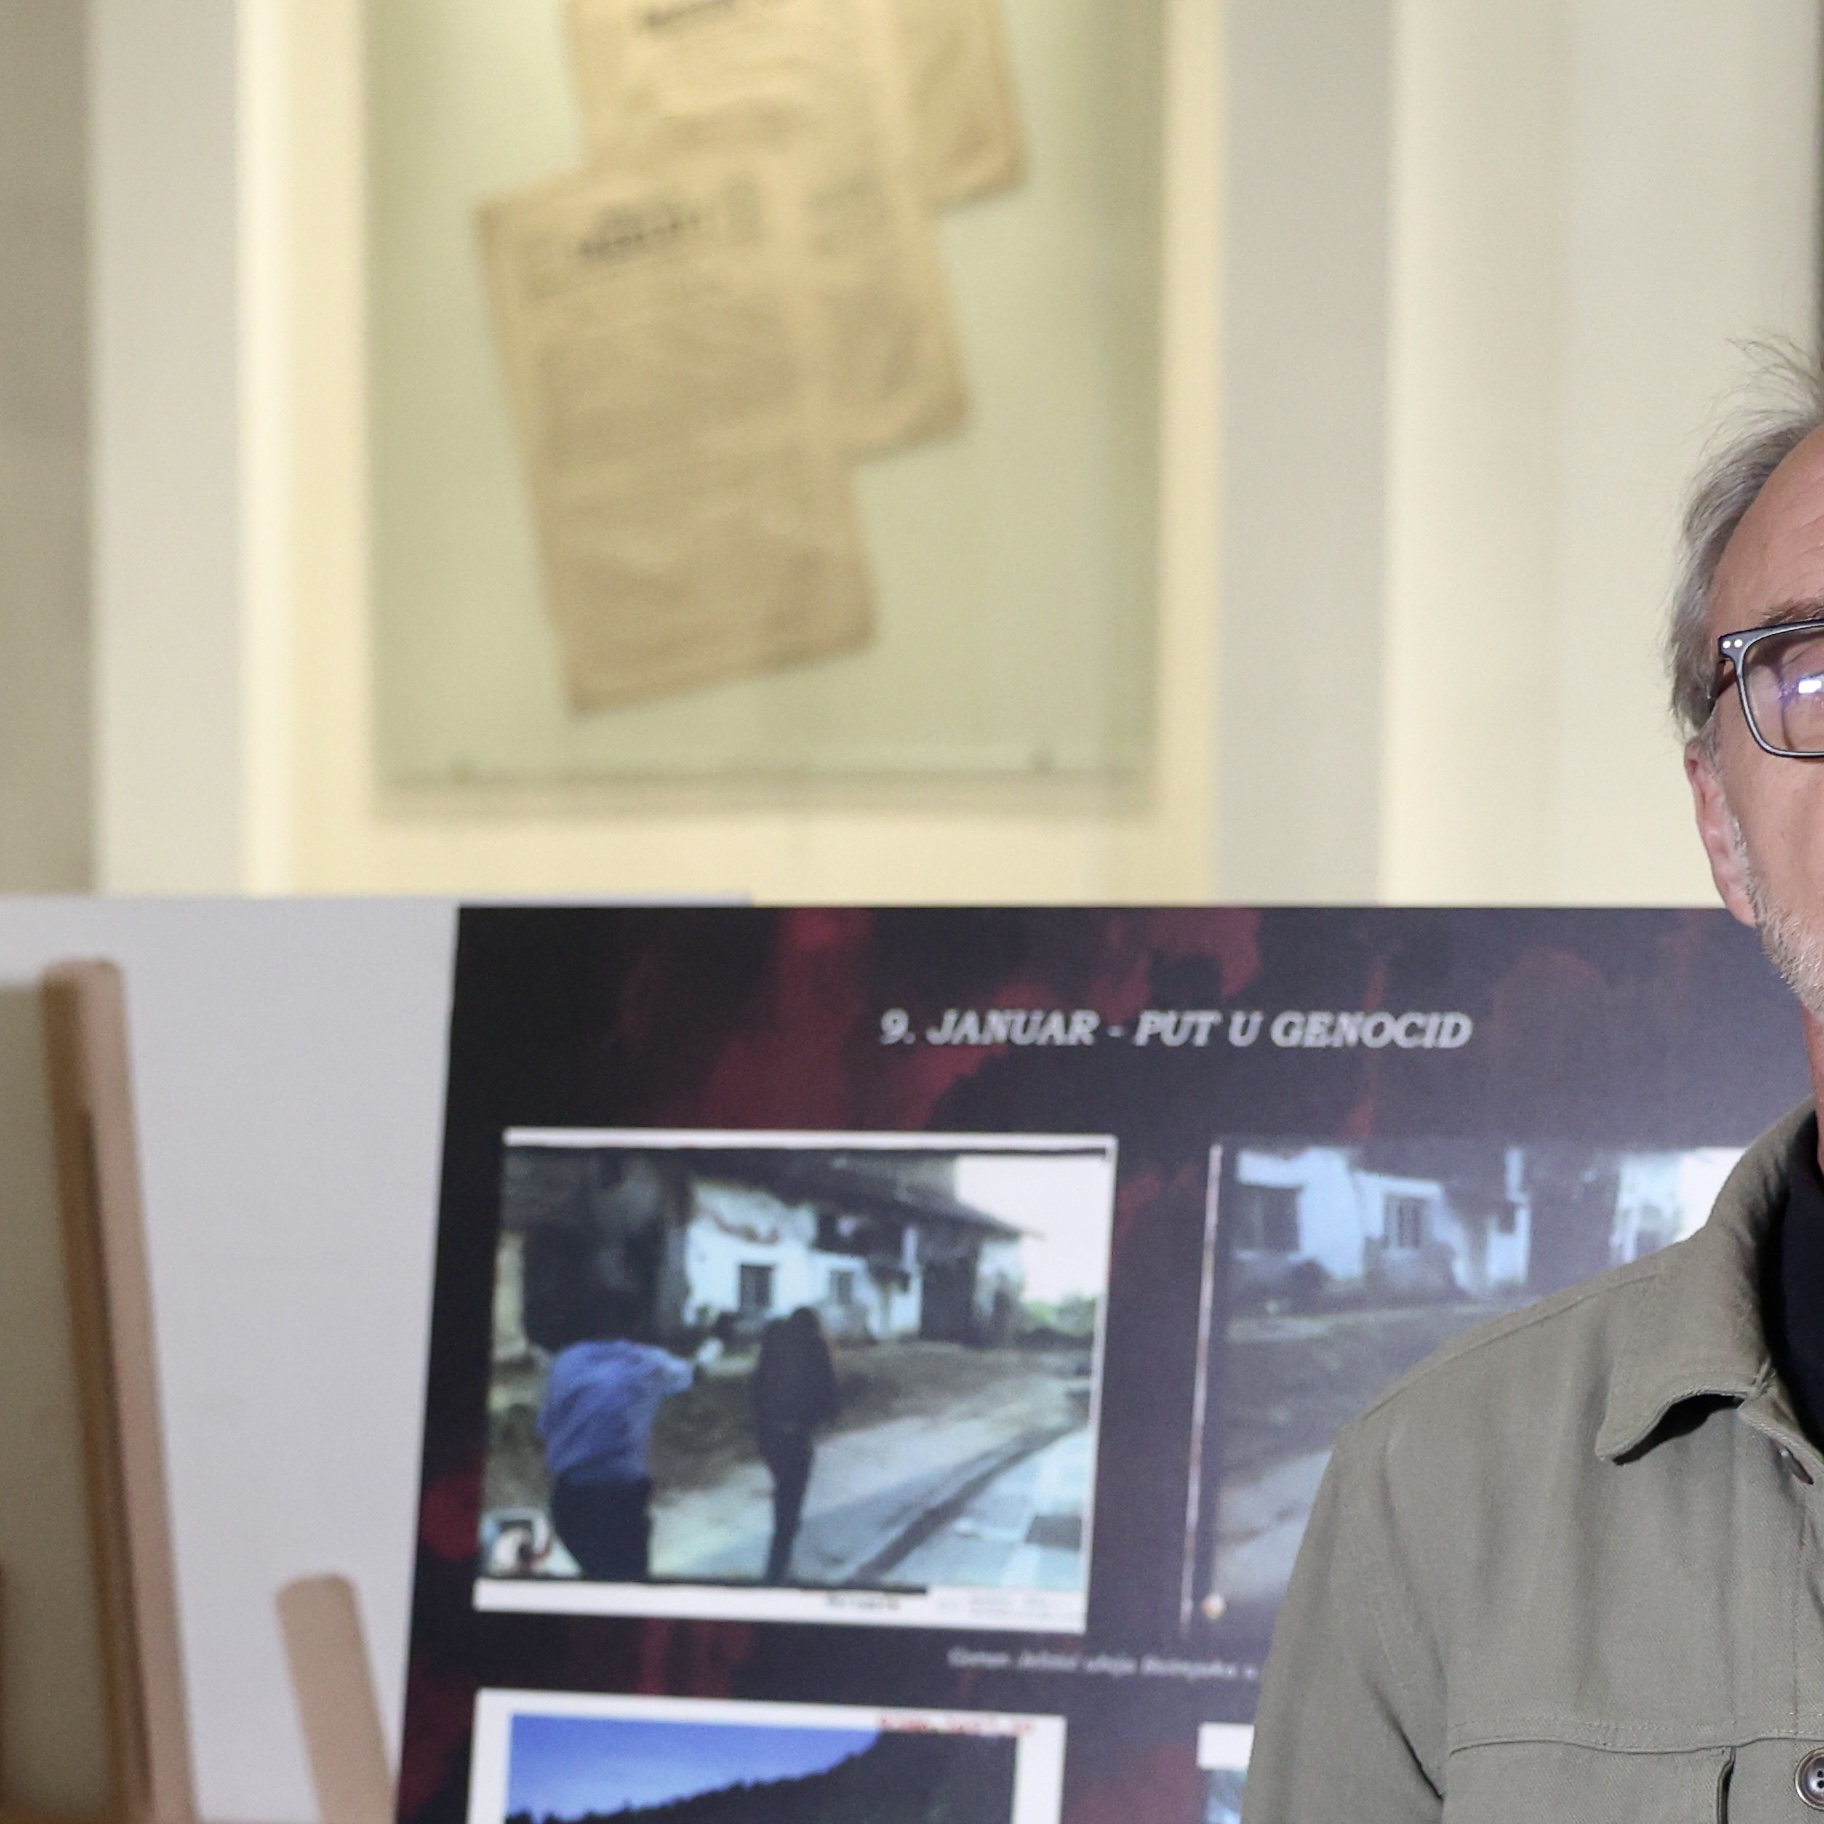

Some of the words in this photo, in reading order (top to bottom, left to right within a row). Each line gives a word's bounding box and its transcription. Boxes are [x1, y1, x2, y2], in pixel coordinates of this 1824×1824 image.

[879, 1008, 916, 1046] 9.
[925, 1008, 1100, 1047] JANUAR
[1133, 1009, 1222, 1048] PUT
[1228, 1010, 1264, 1048] U
[1270, 1011, 1474, 1050] GENOCID
